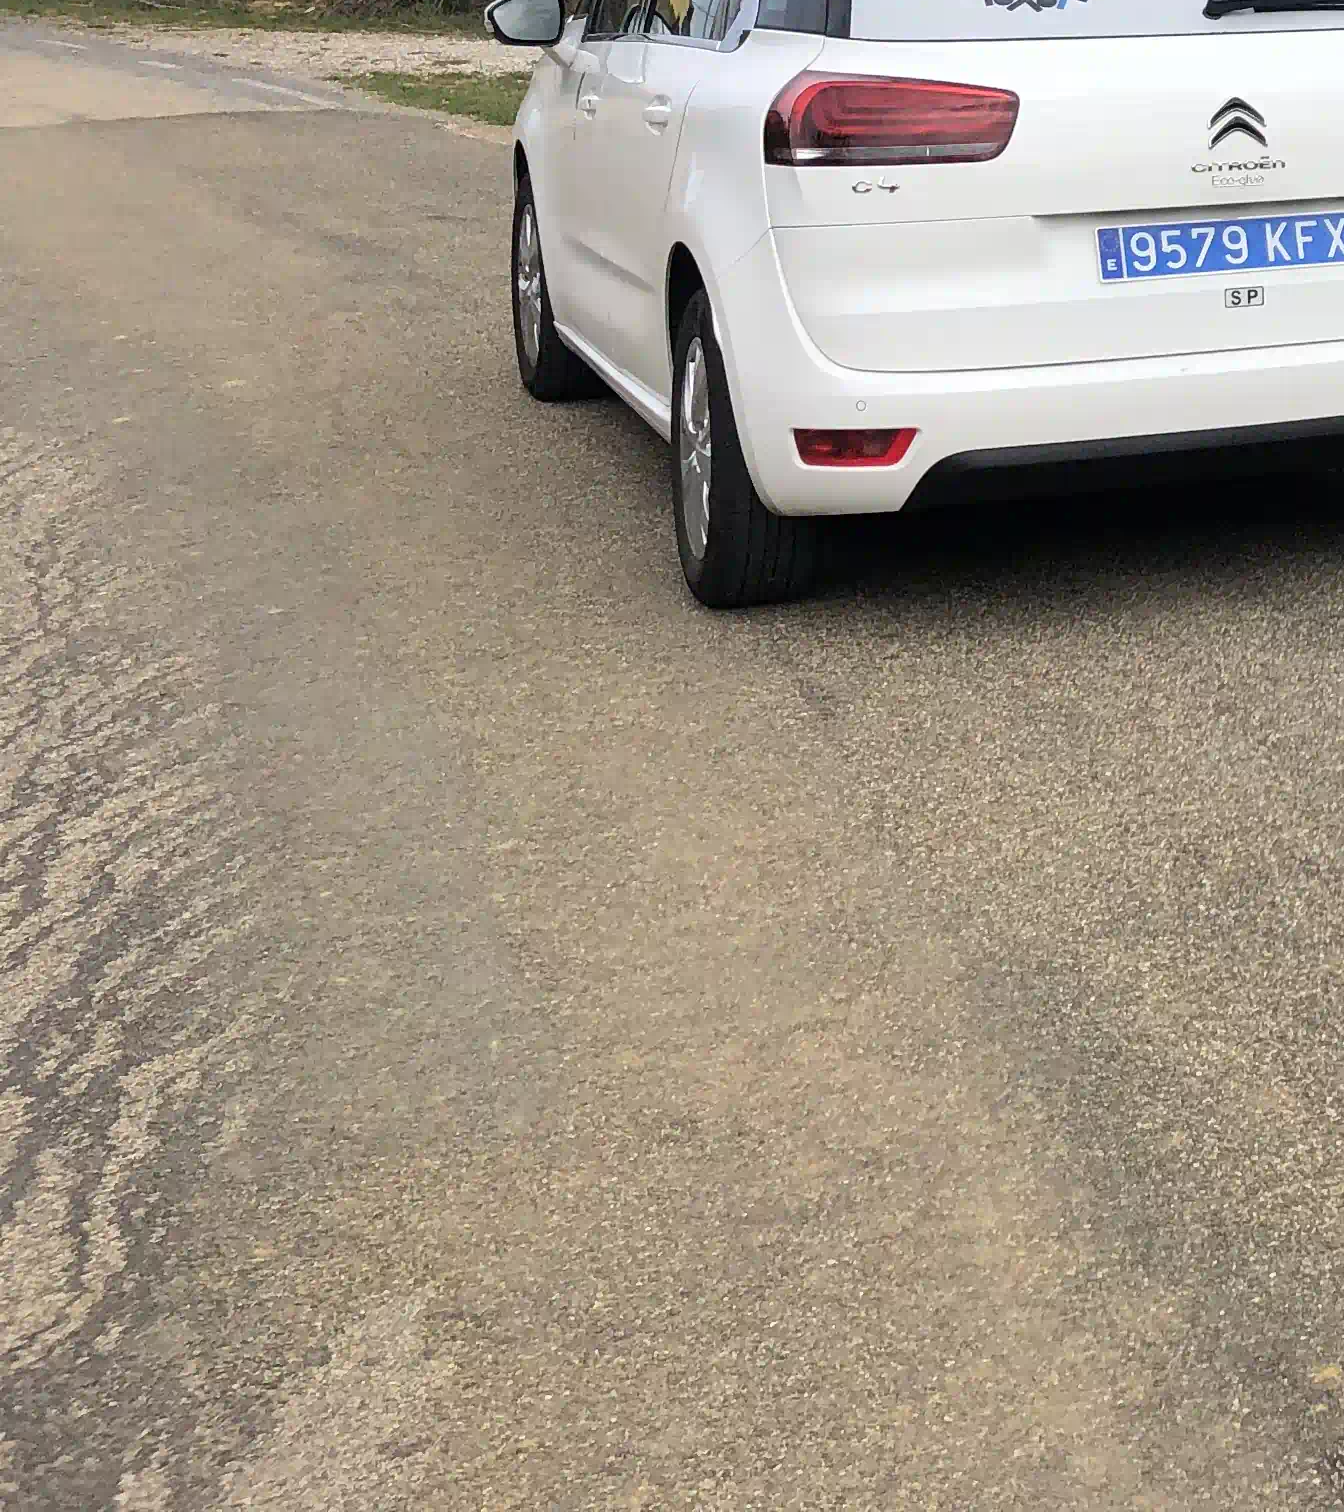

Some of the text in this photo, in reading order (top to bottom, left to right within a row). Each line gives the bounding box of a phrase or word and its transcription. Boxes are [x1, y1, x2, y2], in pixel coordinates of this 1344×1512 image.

[852, 175, 901, 193] C4
[1129, 225, 1249, 272] 9579
[1106, 258, 1118, 271] E
